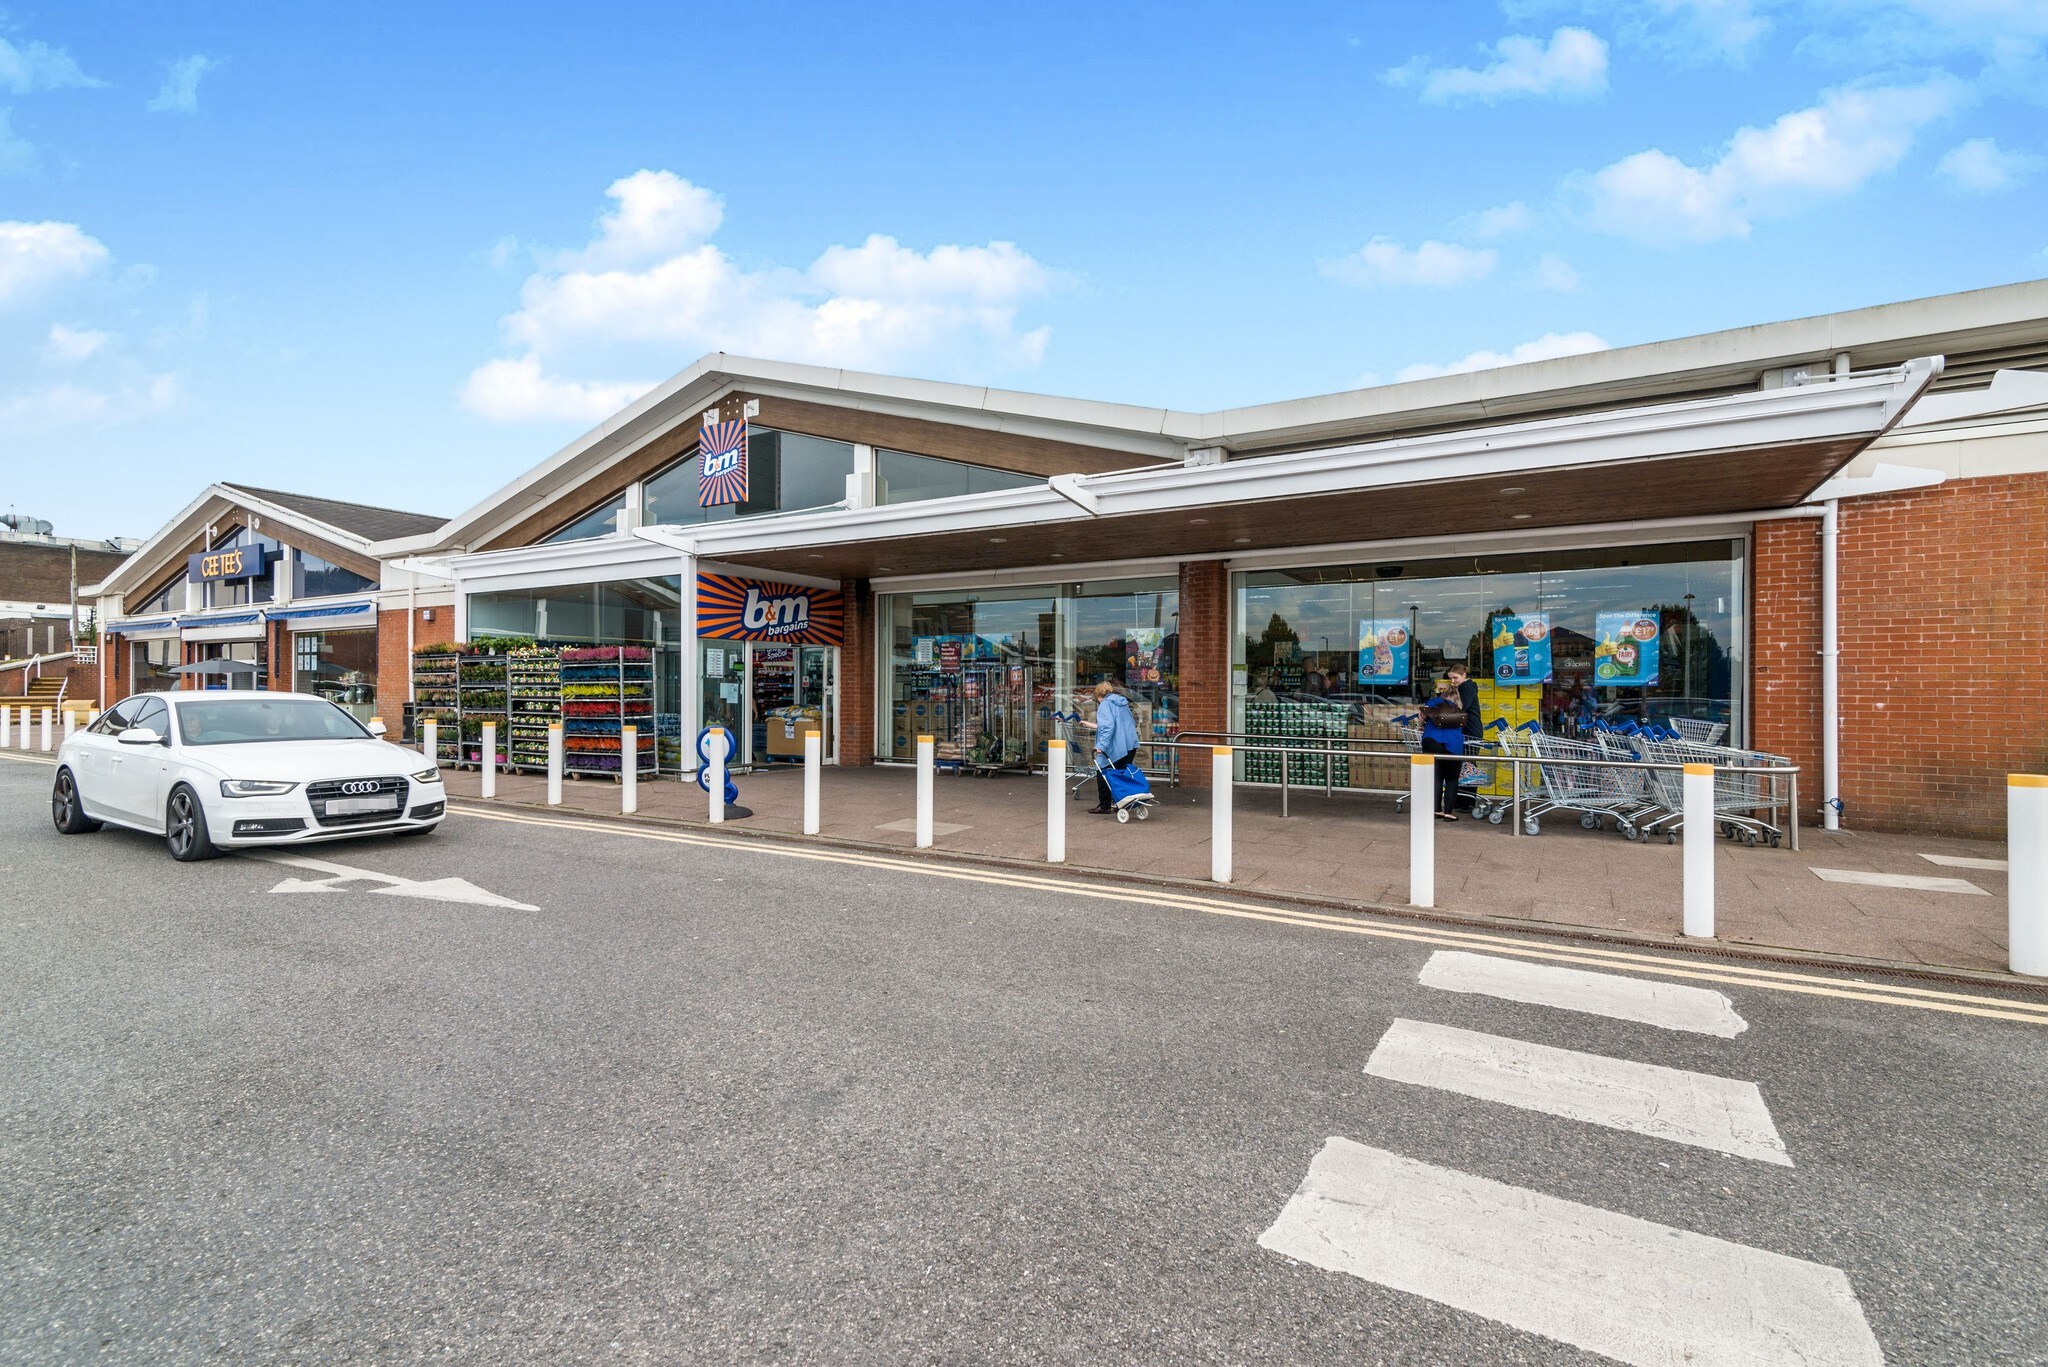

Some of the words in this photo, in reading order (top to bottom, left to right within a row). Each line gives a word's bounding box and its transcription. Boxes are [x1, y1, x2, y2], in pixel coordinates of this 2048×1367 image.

[703, 448, 738, 477] b&m
[220, 549, 243, 576] TEE'S
[744, 588, 809, 629] b&m
[768, 620, 809, 636] bargains
[767, 649, 788, 660] Special
